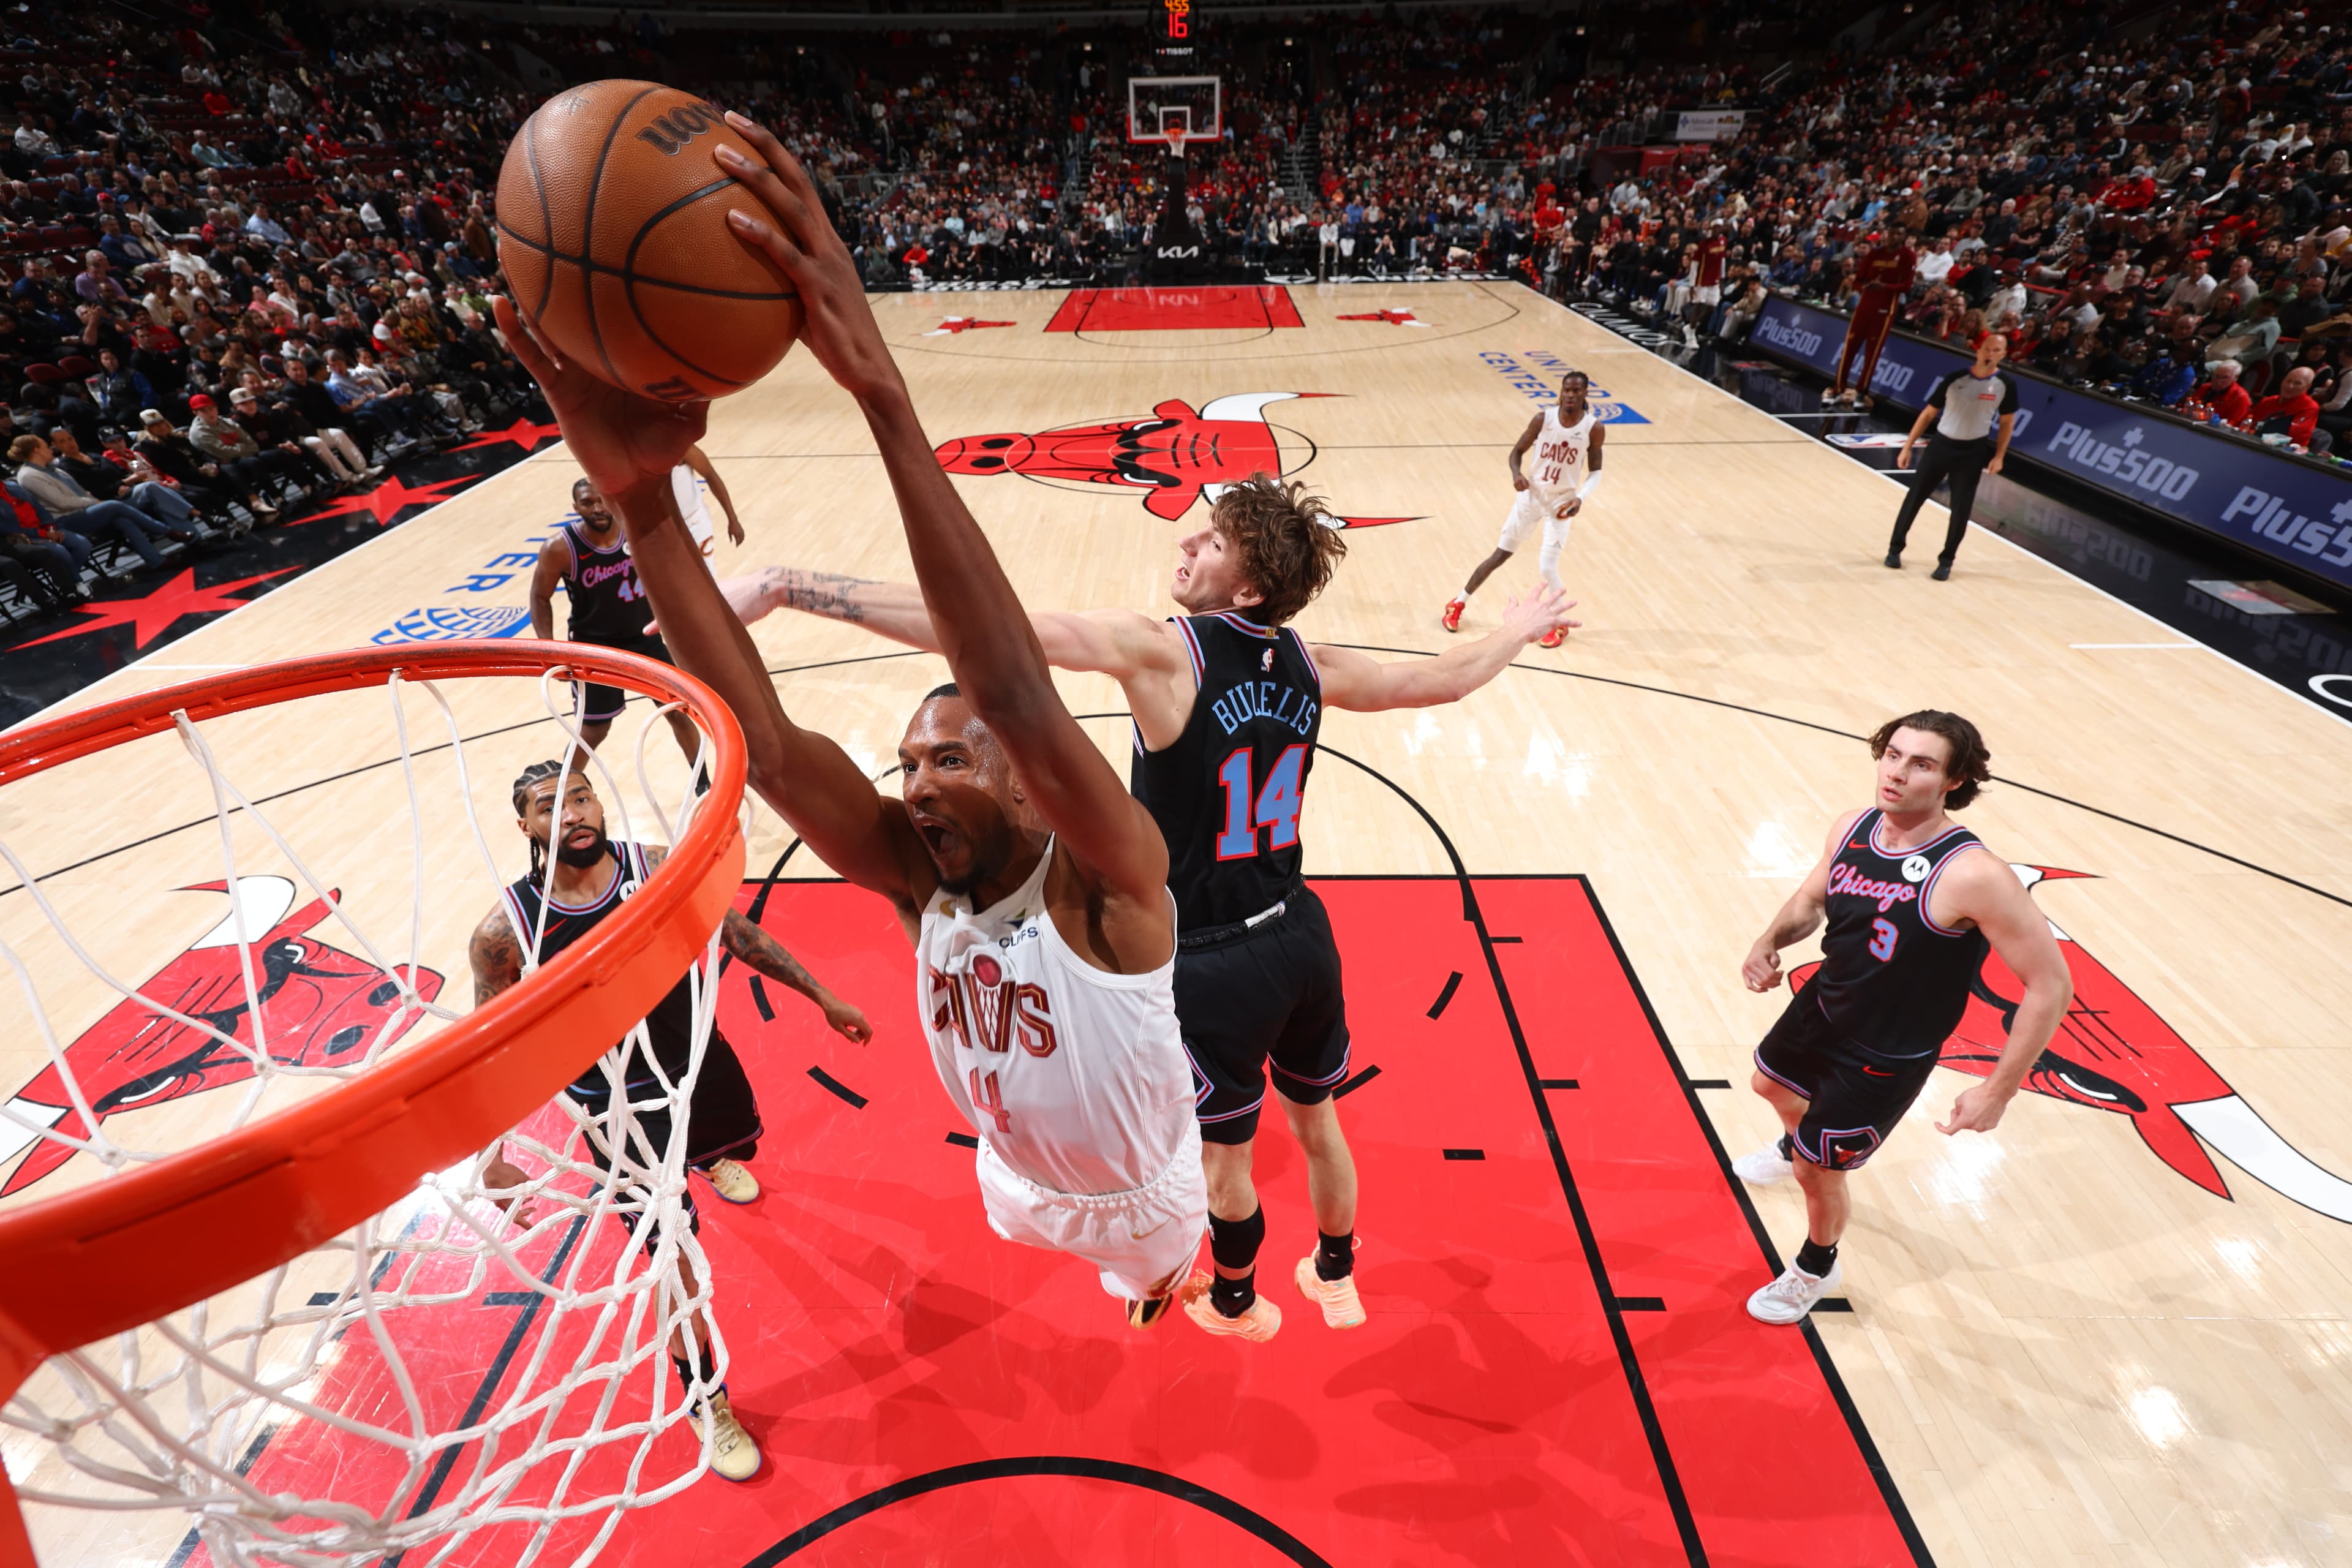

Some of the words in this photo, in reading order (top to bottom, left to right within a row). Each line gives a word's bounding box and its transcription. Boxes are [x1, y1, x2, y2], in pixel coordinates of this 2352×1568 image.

[1169, 12, 1188, 38] 16
[1166, 47, 1193, 56] TISSOT
[1157, 246, 1199, 258] KIA
[1757, 316, 1823, 356] Plus500
[1479, 352, 1558, 399] CENTER
[1540, 442, 1578, 465] CAVS
[1542, 466, 1562, 484] 14
[2047, 421, 2199, 502] Plus500
[617, 578, 646, 603] 44
[1212, 680, 1317, 736] BUZELIS
[1216, 744, 1310, 862] 14
[1827, 863, 1917, 913] Chicago
[1868, 918, 1899, 962] 3
[929, 963, 1057, 1058] CAVS
[969, 1066, 1011, 1134] 4
